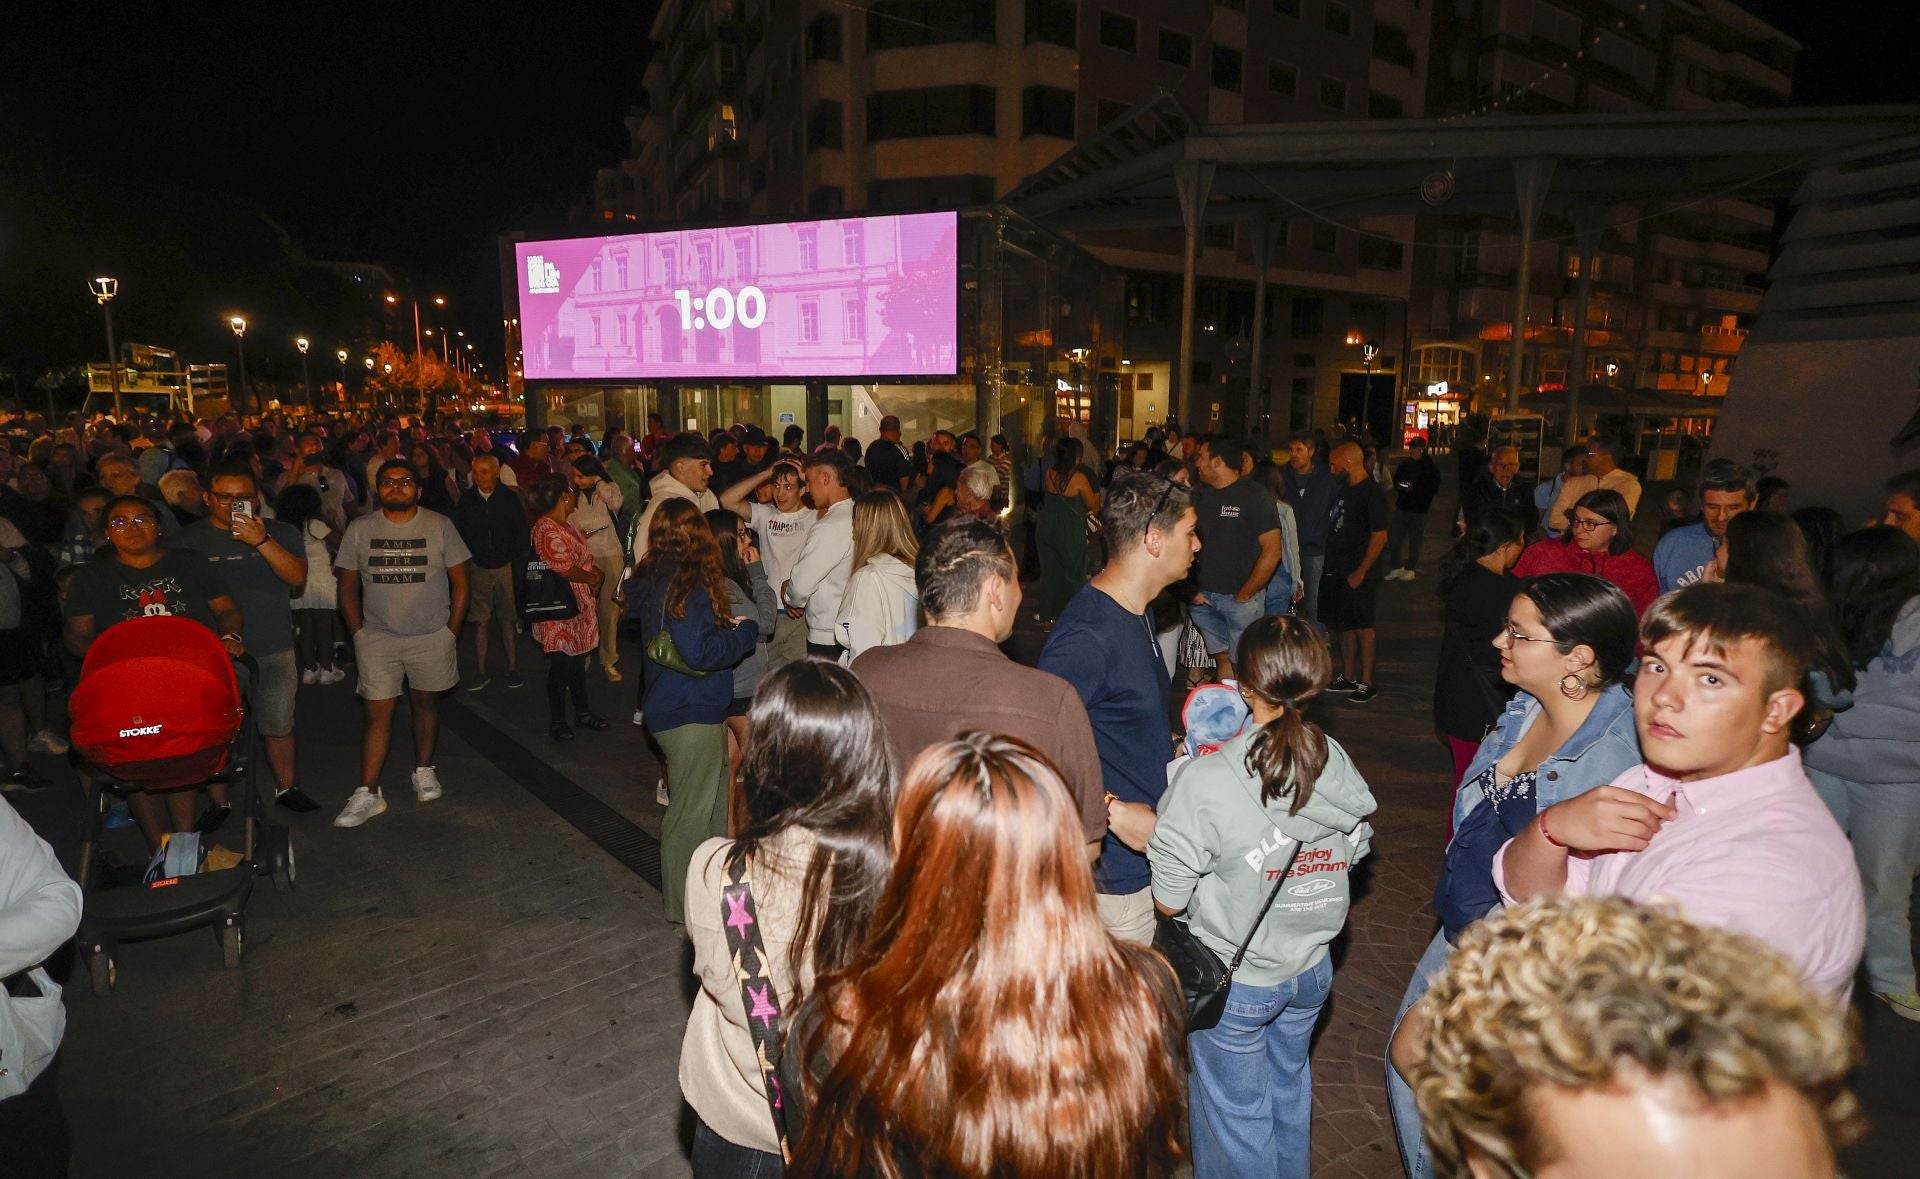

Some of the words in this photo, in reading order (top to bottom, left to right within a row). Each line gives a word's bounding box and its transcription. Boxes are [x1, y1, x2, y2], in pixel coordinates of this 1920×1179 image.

[675, 286, 767, 330] 1:00
[382, 540, 413, 549] AMS
[382, 557, 412, 566] TER
[381, 574, 413, 583] DAM
[119, 724, 163, 737] STOKKE
[1294, 848, 1333, 863] Enjoy
[1297, 861, 1348, 877] Summ
